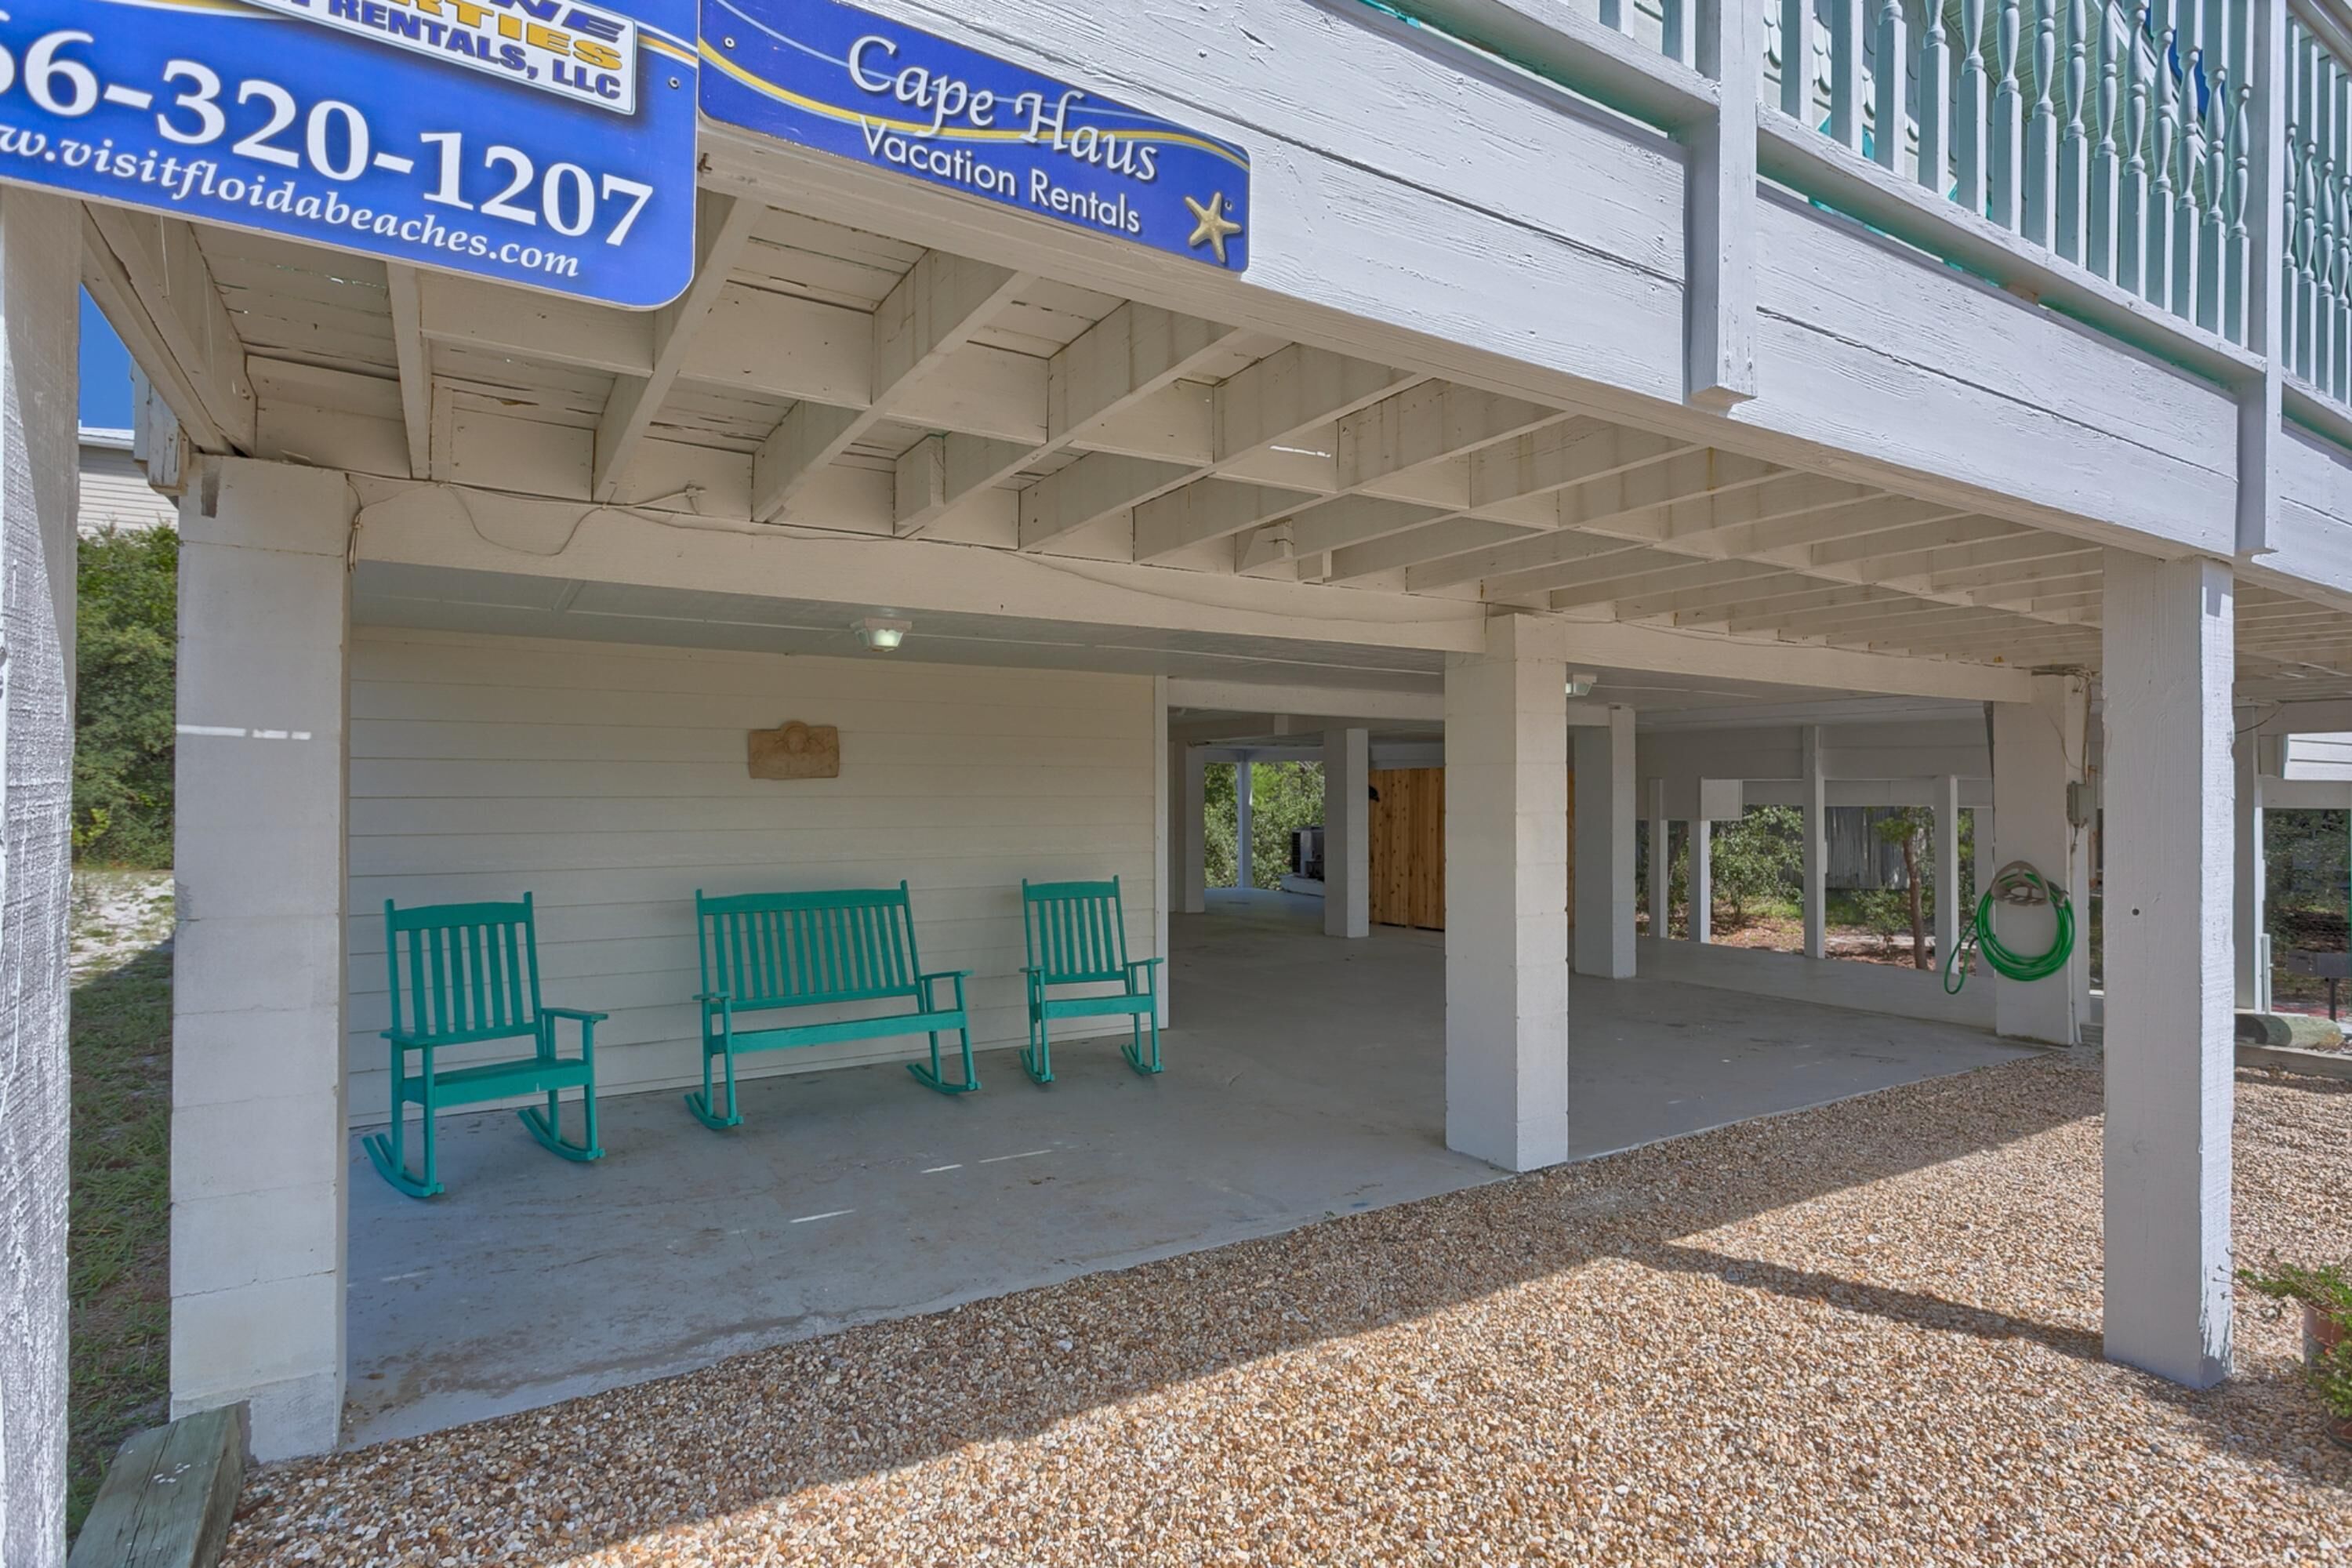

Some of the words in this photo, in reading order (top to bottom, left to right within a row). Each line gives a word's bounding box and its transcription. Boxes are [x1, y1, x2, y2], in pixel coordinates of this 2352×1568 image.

[328, 0, 539, 79] RENTALS,
[552, 58, 621, 100] LLC
[848, 35, 994, 137] Cape
[1014, 89, 1158, 181] Haus
[0, 9, 654, 247] 6-320-1207
[858, 114, 1016, 197] Vacation
[1030, 168, 1141, 234] Rentals
